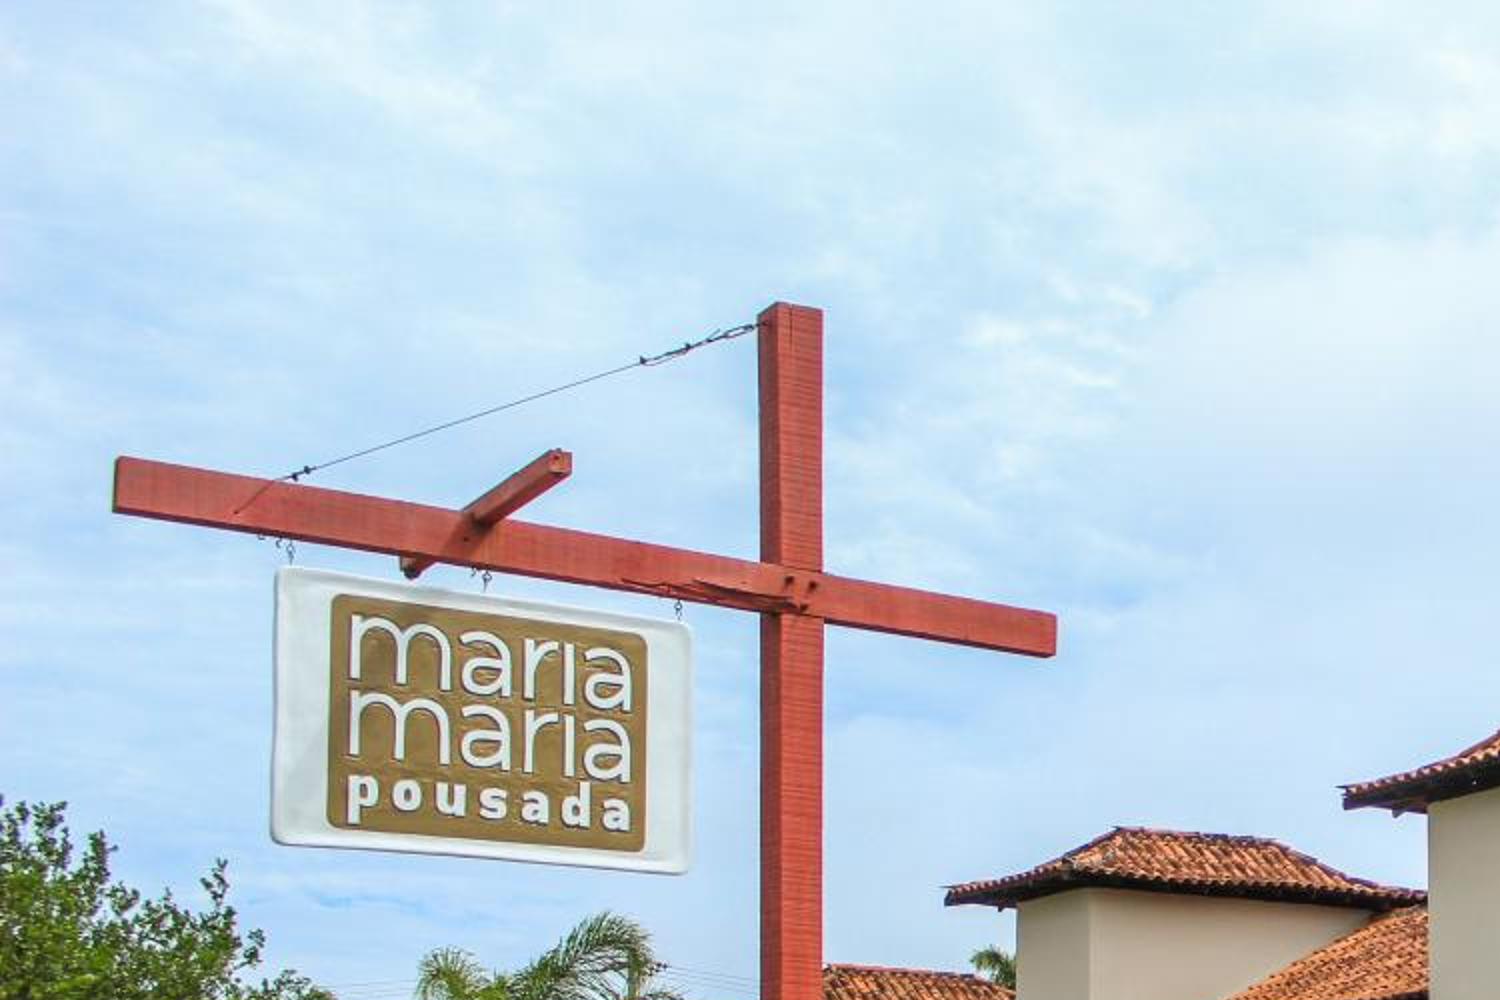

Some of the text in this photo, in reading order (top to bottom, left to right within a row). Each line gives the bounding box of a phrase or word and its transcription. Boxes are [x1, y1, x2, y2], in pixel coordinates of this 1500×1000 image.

[348, 614, 632, 712] maria
[348, 688, 632, 783] maria
[347, 773, 632, 831] pousada
